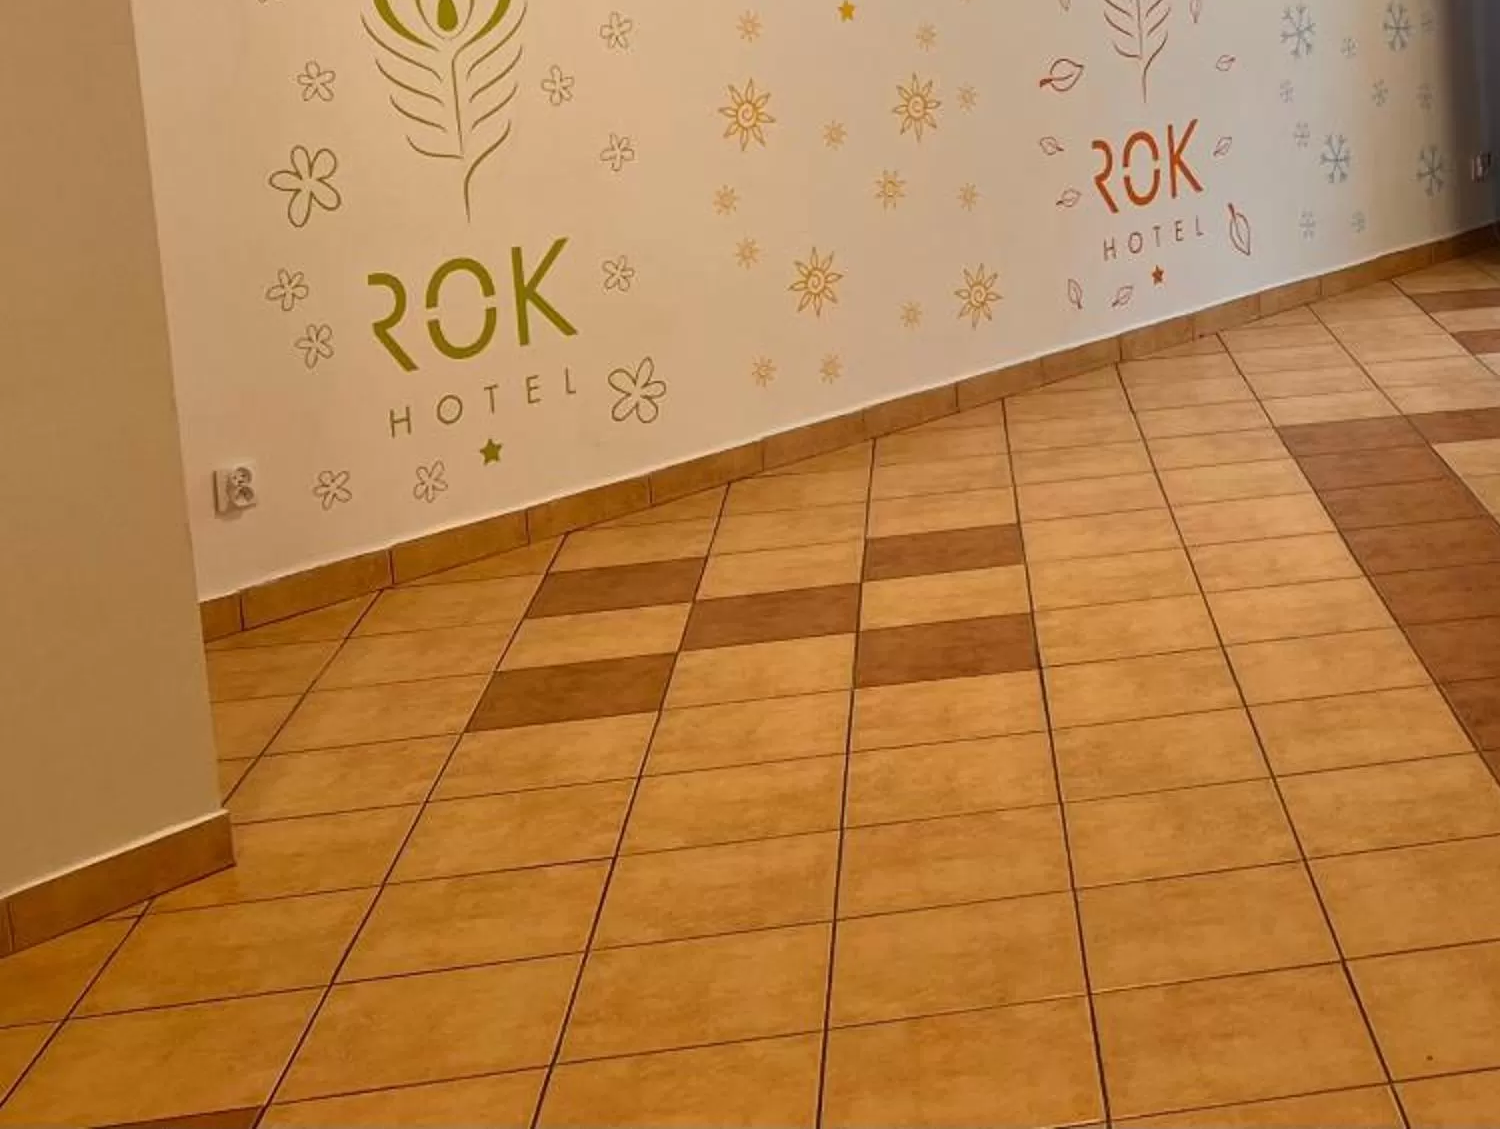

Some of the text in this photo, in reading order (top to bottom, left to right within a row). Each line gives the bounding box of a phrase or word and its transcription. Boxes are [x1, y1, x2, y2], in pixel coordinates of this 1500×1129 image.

[1091, 118, 1204, 214] ROK
[1103, 215, 1204, 261] HOTEL
[367, 237, 578, 372] ROK
[389, 367, 577, 439] HOTEL
